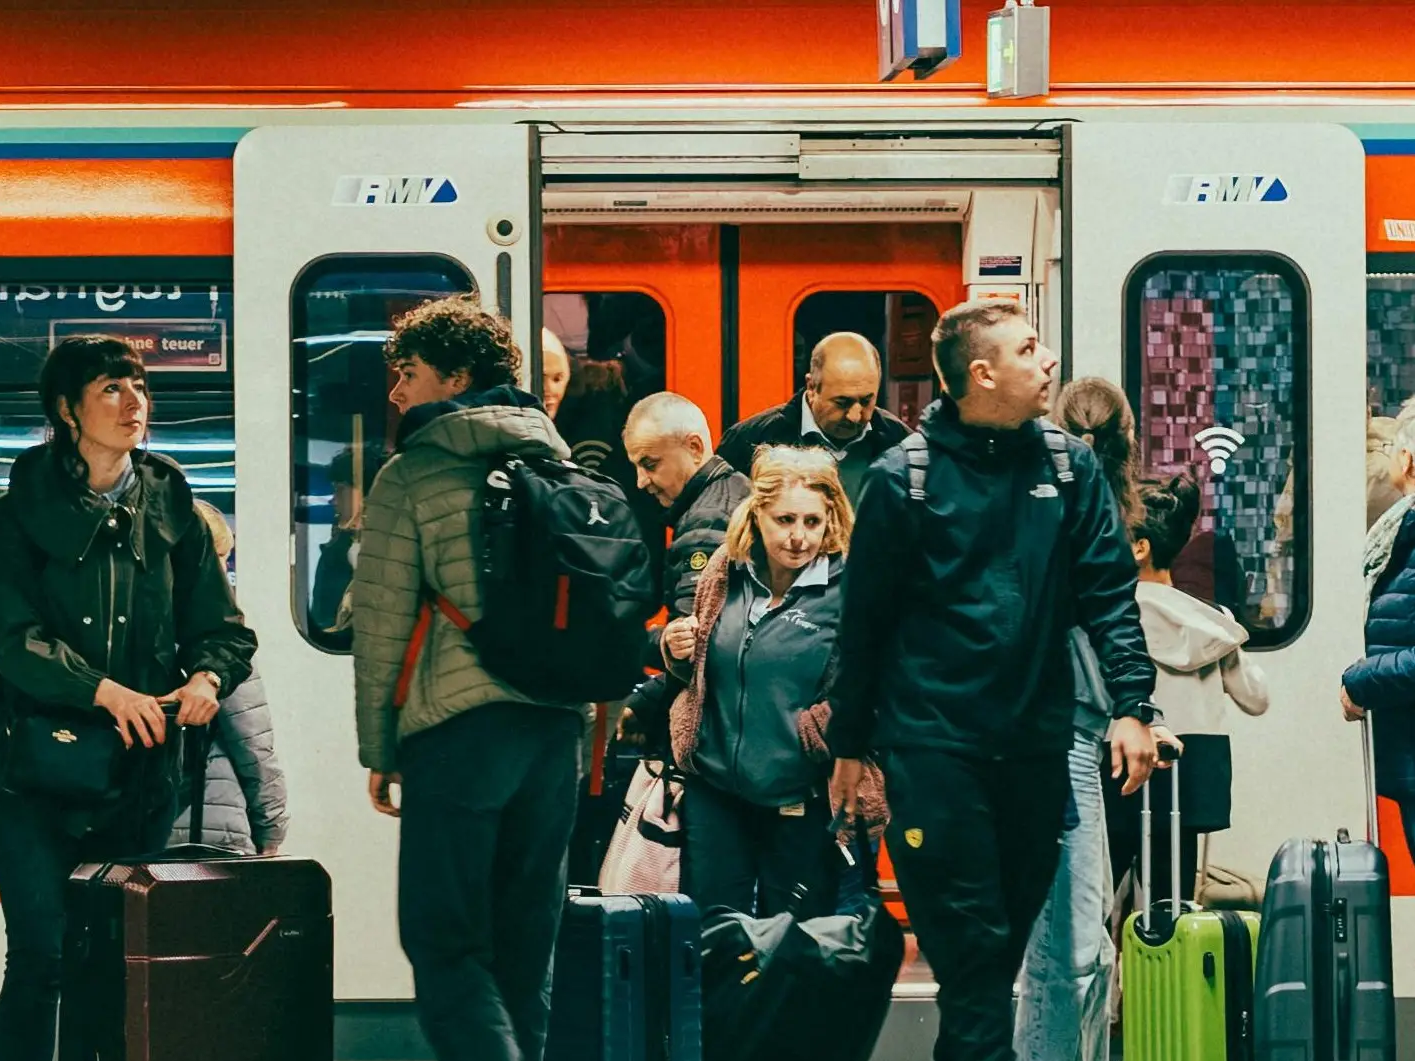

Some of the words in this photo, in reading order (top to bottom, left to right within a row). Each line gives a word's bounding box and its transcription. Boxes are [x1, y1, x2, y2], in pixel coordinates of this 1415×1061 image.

[357, 177, 448, 204] RMV
[1187, 175, 1278, 203] RMV
[124, 337, 154, 350] hne
[161, 337, 205, 351] teuer
